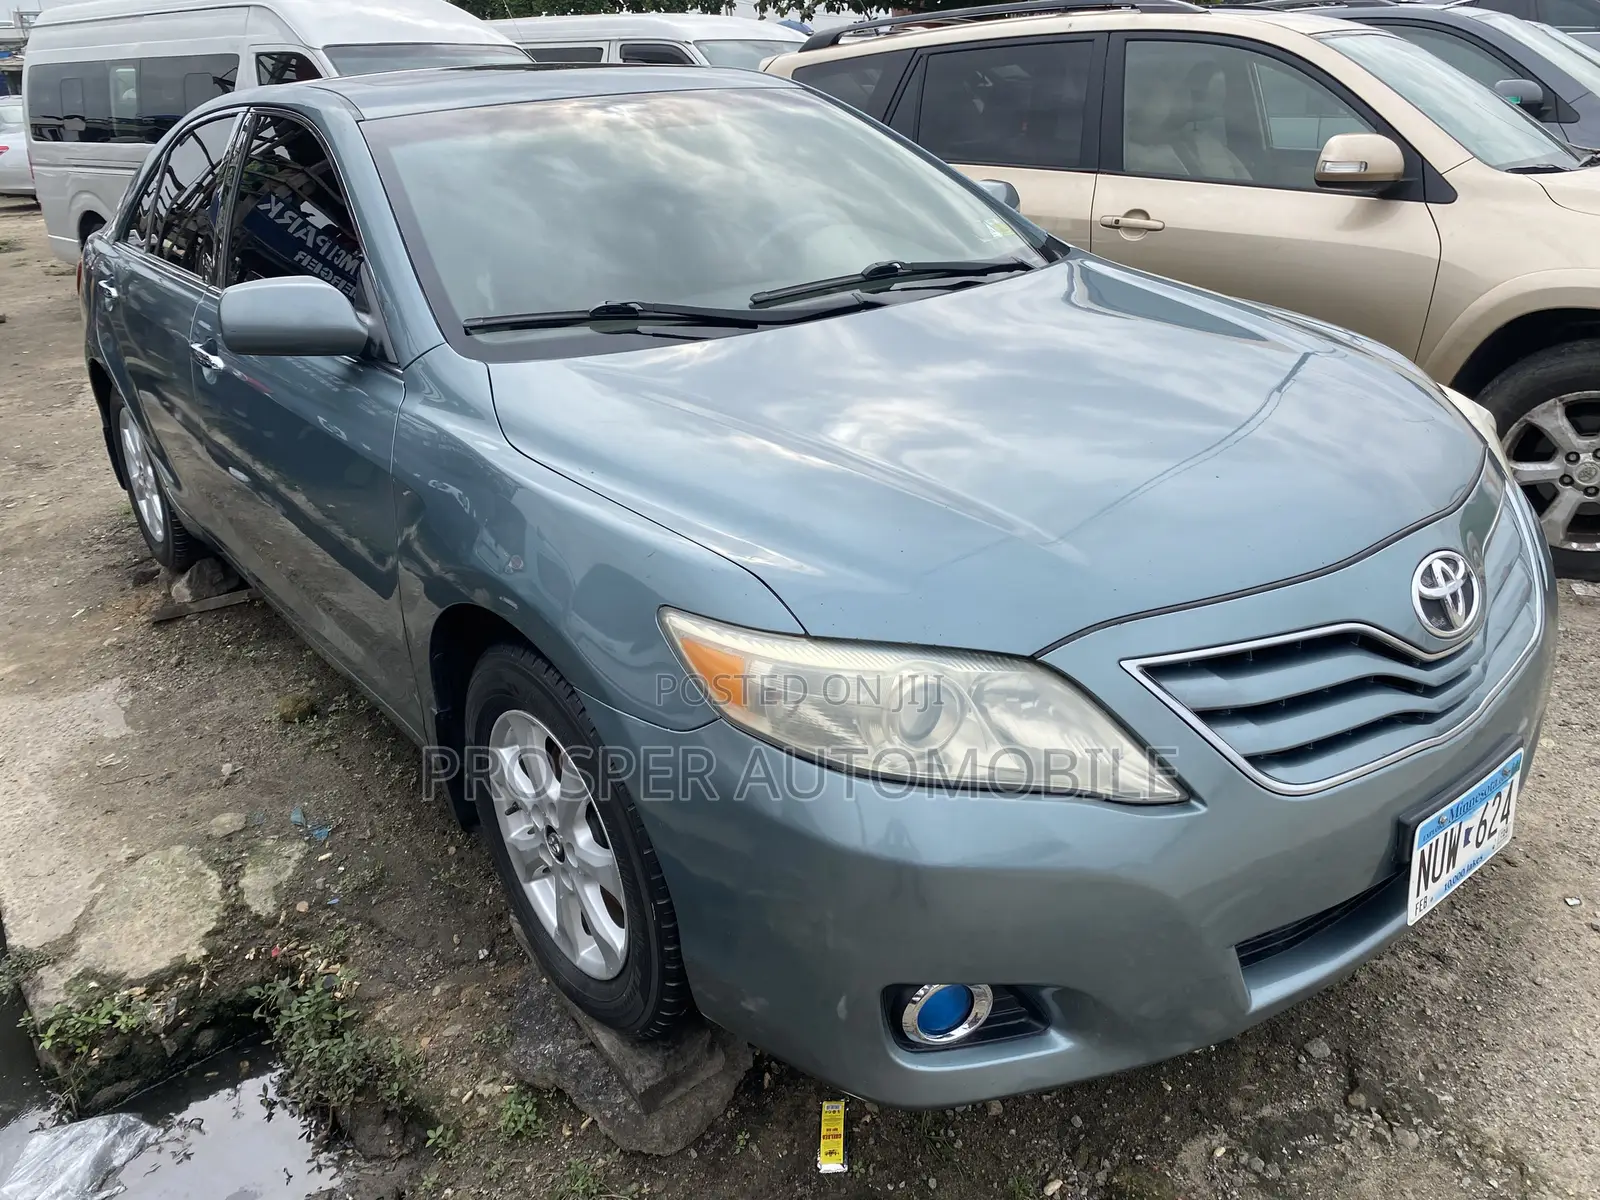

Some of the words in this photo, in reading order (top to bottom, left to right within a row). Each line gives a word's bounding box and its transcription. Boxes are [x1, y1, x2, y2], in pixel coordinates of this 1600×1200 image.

[1416, 821, 1463, 899] NUW
[1475, 779, 1514, 849] 624
[1415, 895, 1429, 917] FEB
